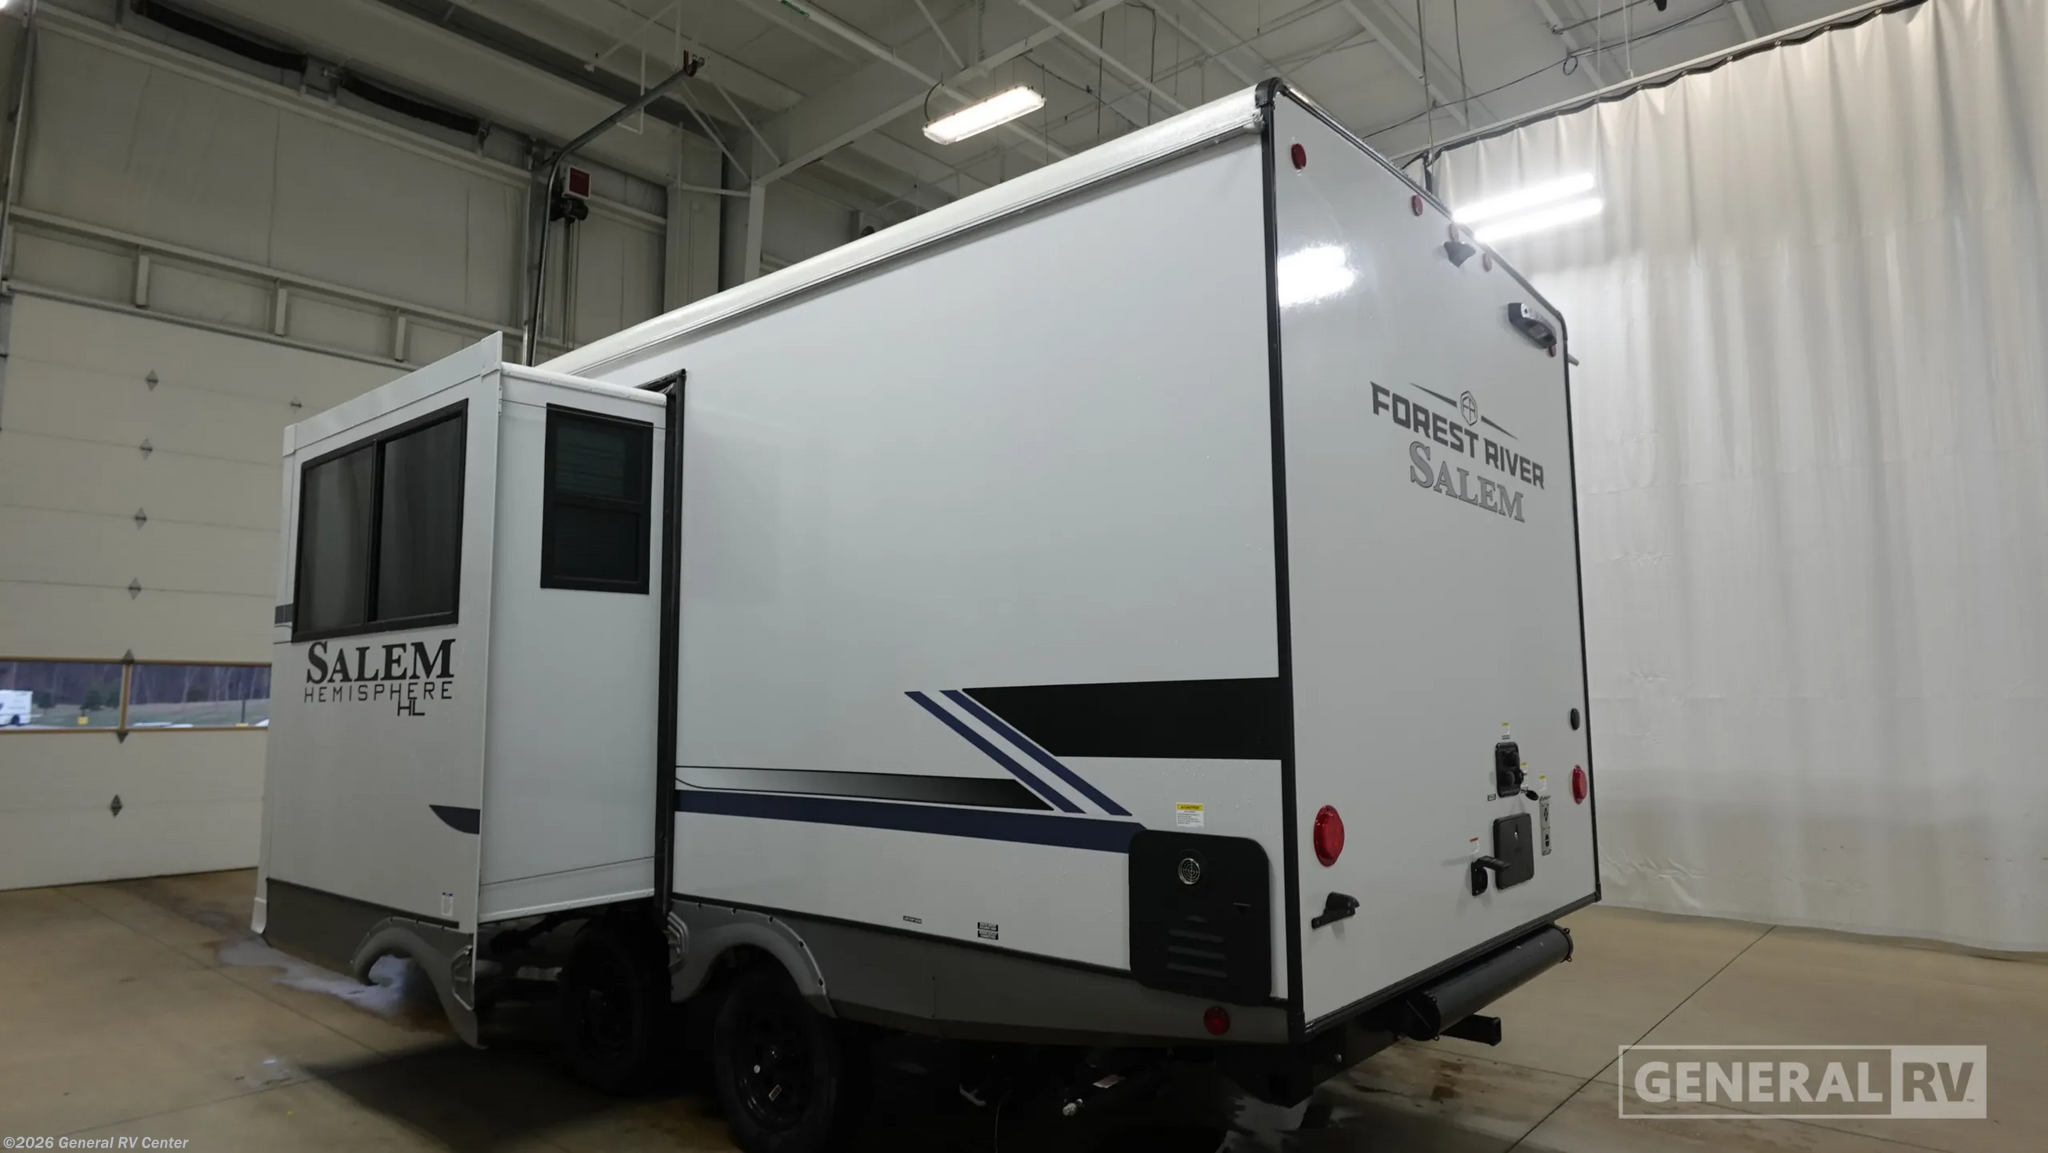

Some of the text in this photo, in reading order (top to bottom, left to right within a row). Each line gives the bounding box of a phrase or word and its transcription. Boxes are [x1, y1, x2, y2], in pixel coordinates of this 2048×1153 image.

[1370, 381, 1545, 490] FOREST RIVER
[1409, 440, 1525, 523] SALEM
[306, 639, 456, 684] SALEM
[304, 681, 453, 703] HEMISPHERE
[397, 699, 426, 716] HL
